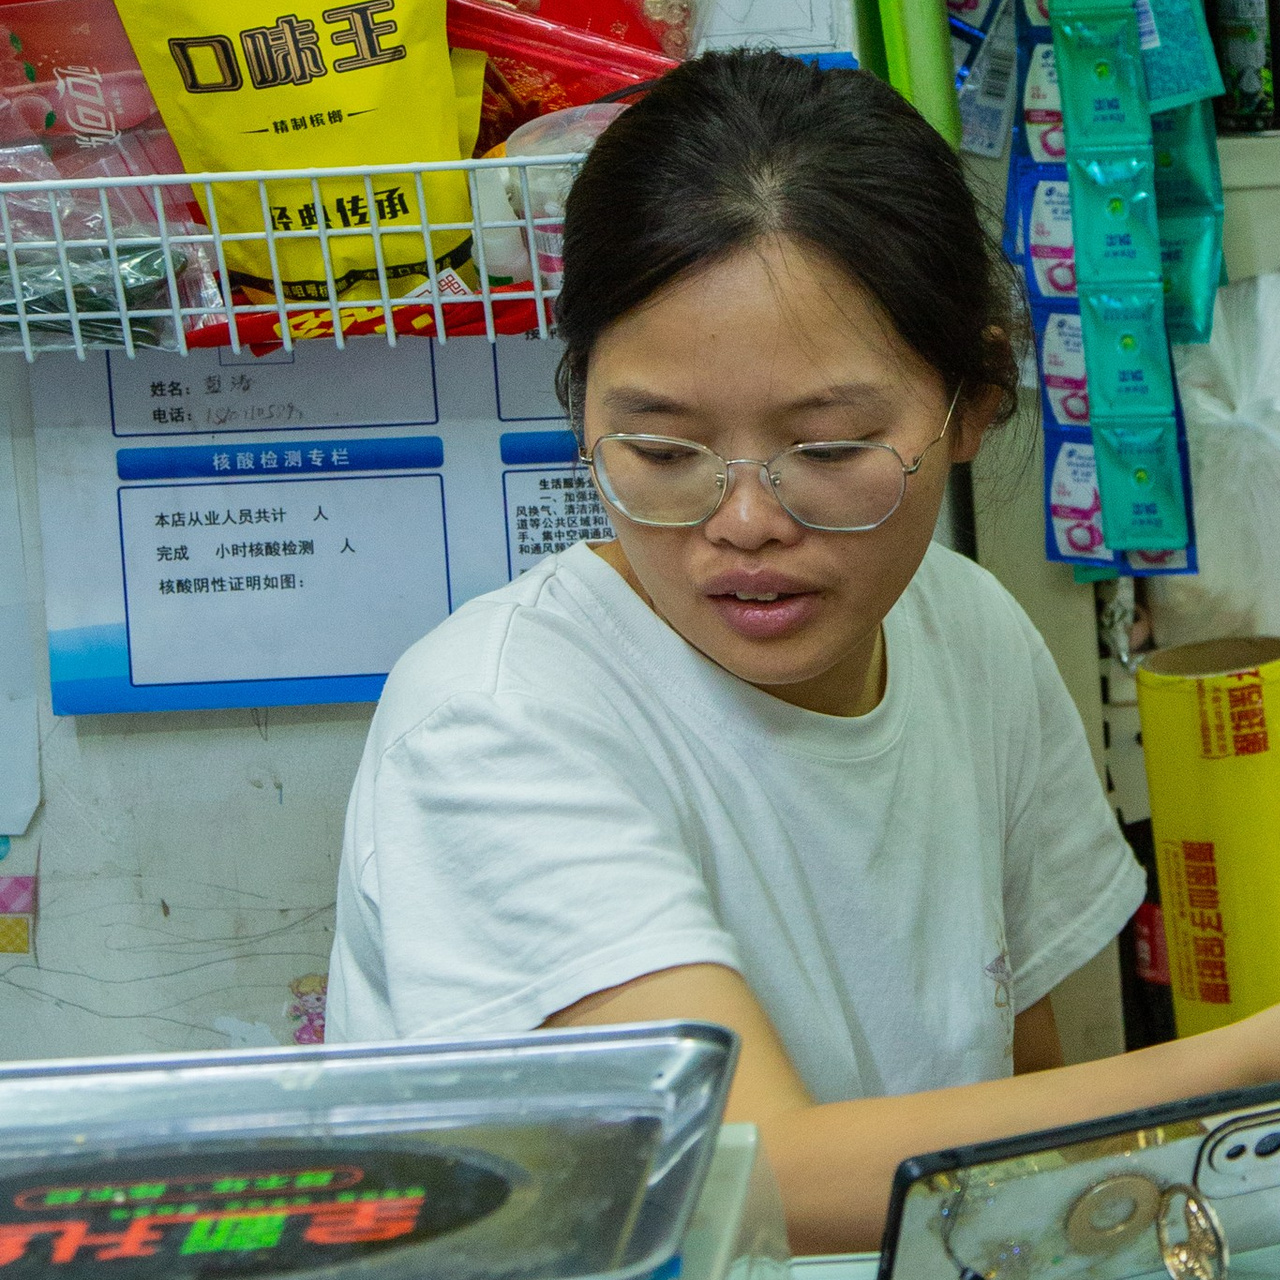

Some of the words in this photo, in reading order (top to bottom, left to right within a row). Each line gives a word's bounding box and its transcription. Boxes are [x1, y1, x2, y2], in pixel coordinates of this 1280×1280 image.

[212, 448, 350, 471] 核酸检测专栏
[154, 507, 287, 528] 本店从业人员共计
[313, 506, 329, 522] 人
[156, 543, 190, 562] 完成
[215, 539, 315, 559] 小时核酸检测
[340, 538, 356, 554] 人
[159, 574, 304, 595] 核酸阴性证明如图：
